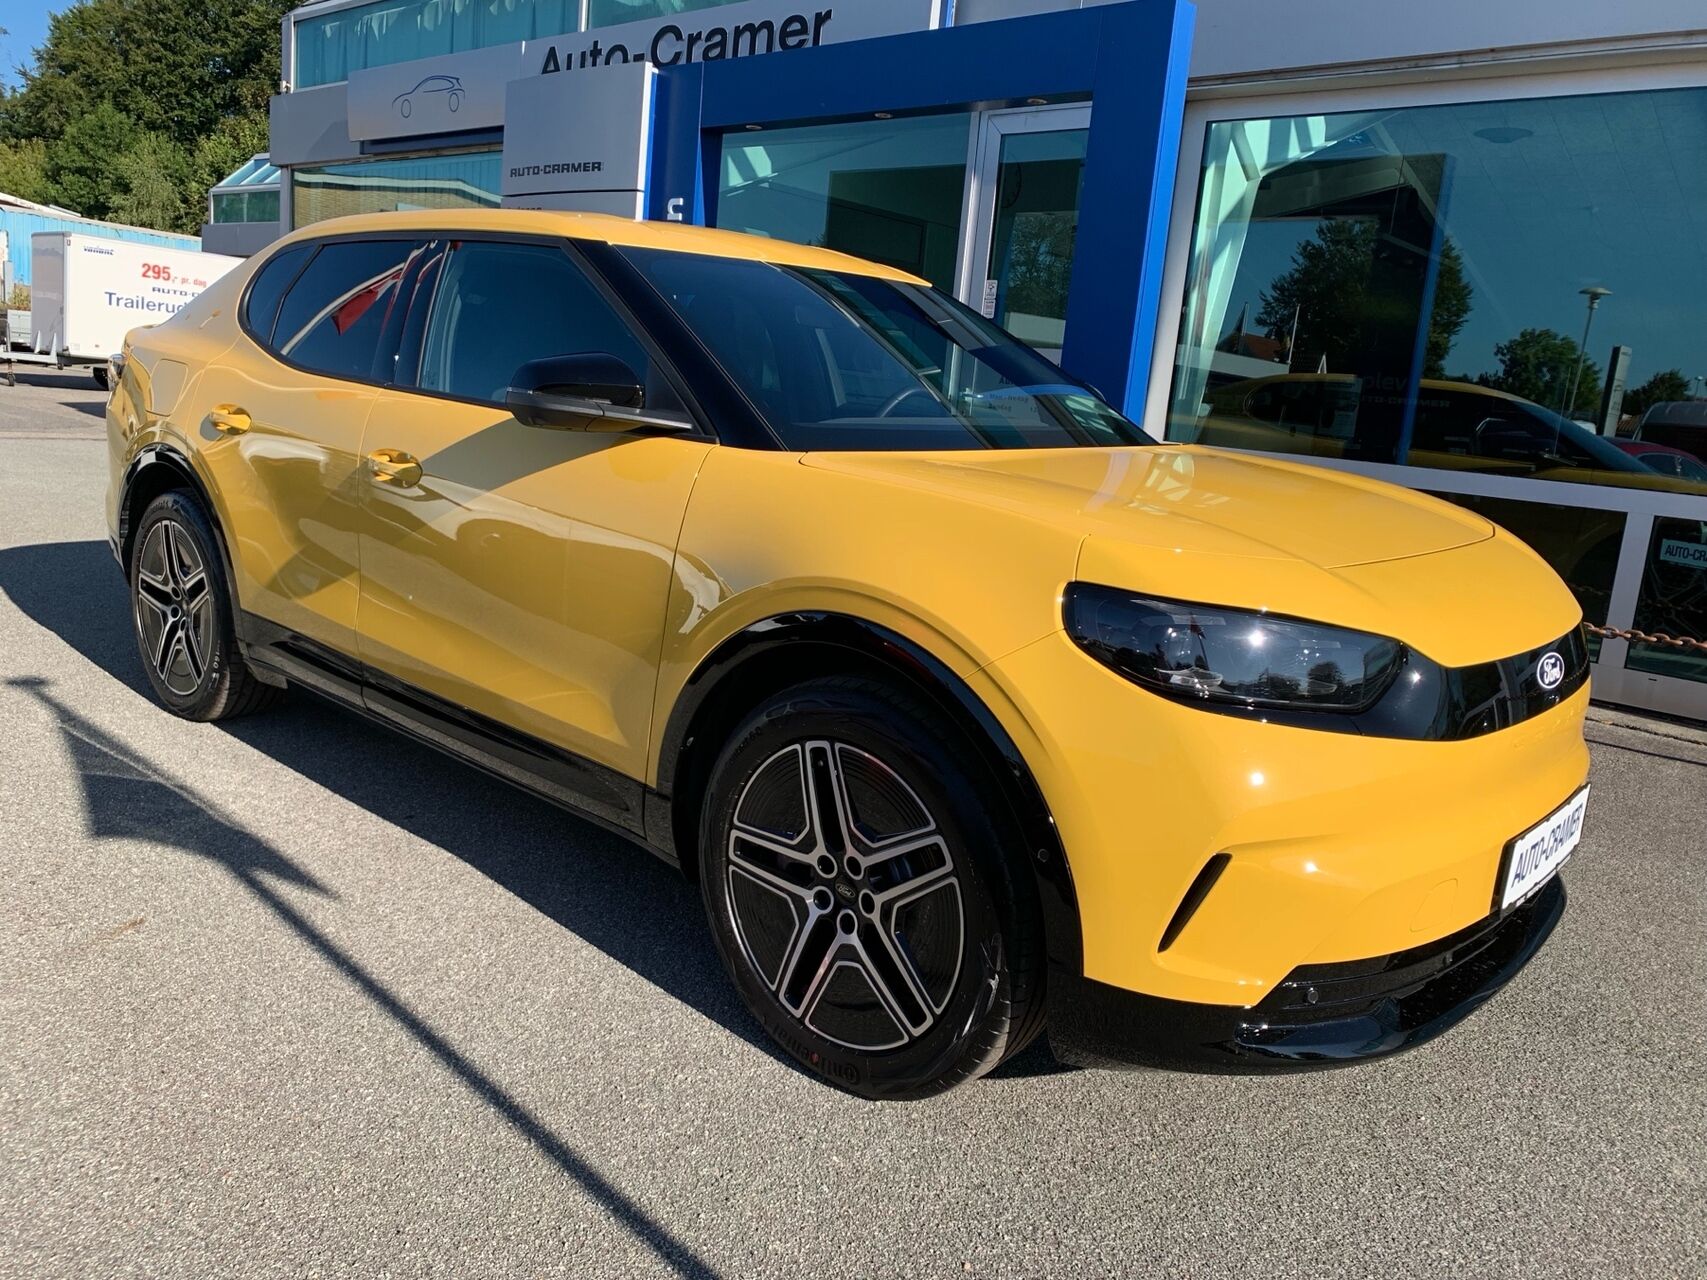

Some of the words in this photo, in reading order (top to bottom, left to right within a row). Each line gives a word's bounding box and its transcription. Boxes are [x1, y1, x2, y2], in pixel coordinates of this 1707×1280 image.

[541, 9, 833, 75] Auto-Cramer
[510, 161, 602, 178] AUTO-CRAMER
[152, 286, 201, 298] AUTO-C
[1543, 657, 1561, 685] Ford
[1511, 802, 1584, 889] AUTO-CRAMER
